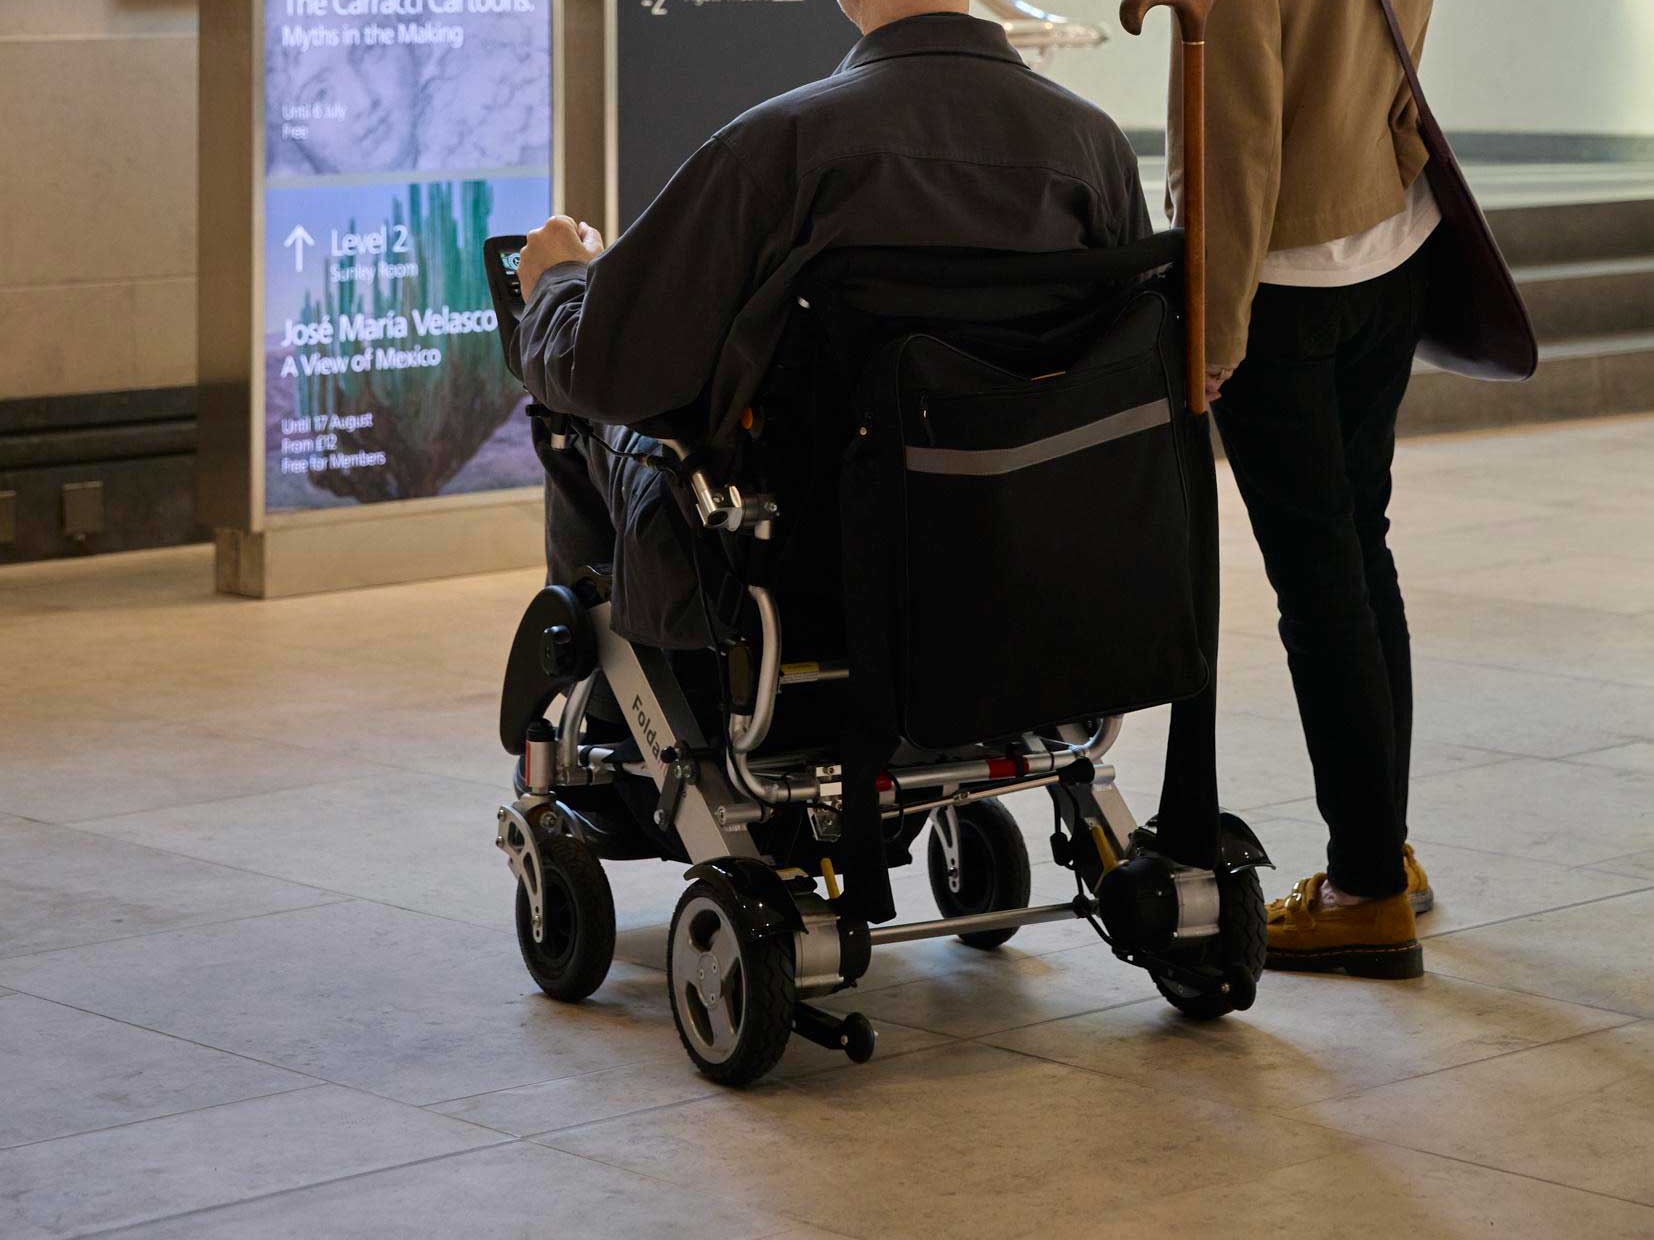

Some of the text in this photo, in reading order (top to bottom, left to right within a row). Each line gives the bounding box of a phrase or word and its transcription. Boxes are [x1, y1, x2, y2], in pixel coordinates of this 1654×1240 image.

[282, 22, 463, 52] Myths in the Making
[331, 224, 410, 257] Level 2
[378, 261, 419, 279] Room
[280, 306, 498, 347] José María Velasco
[280, 344, 442, 378] A View of Mexico
[281, 413, 373, 434] Until 17 August
[281, 450, 386, 474] Free for Members
